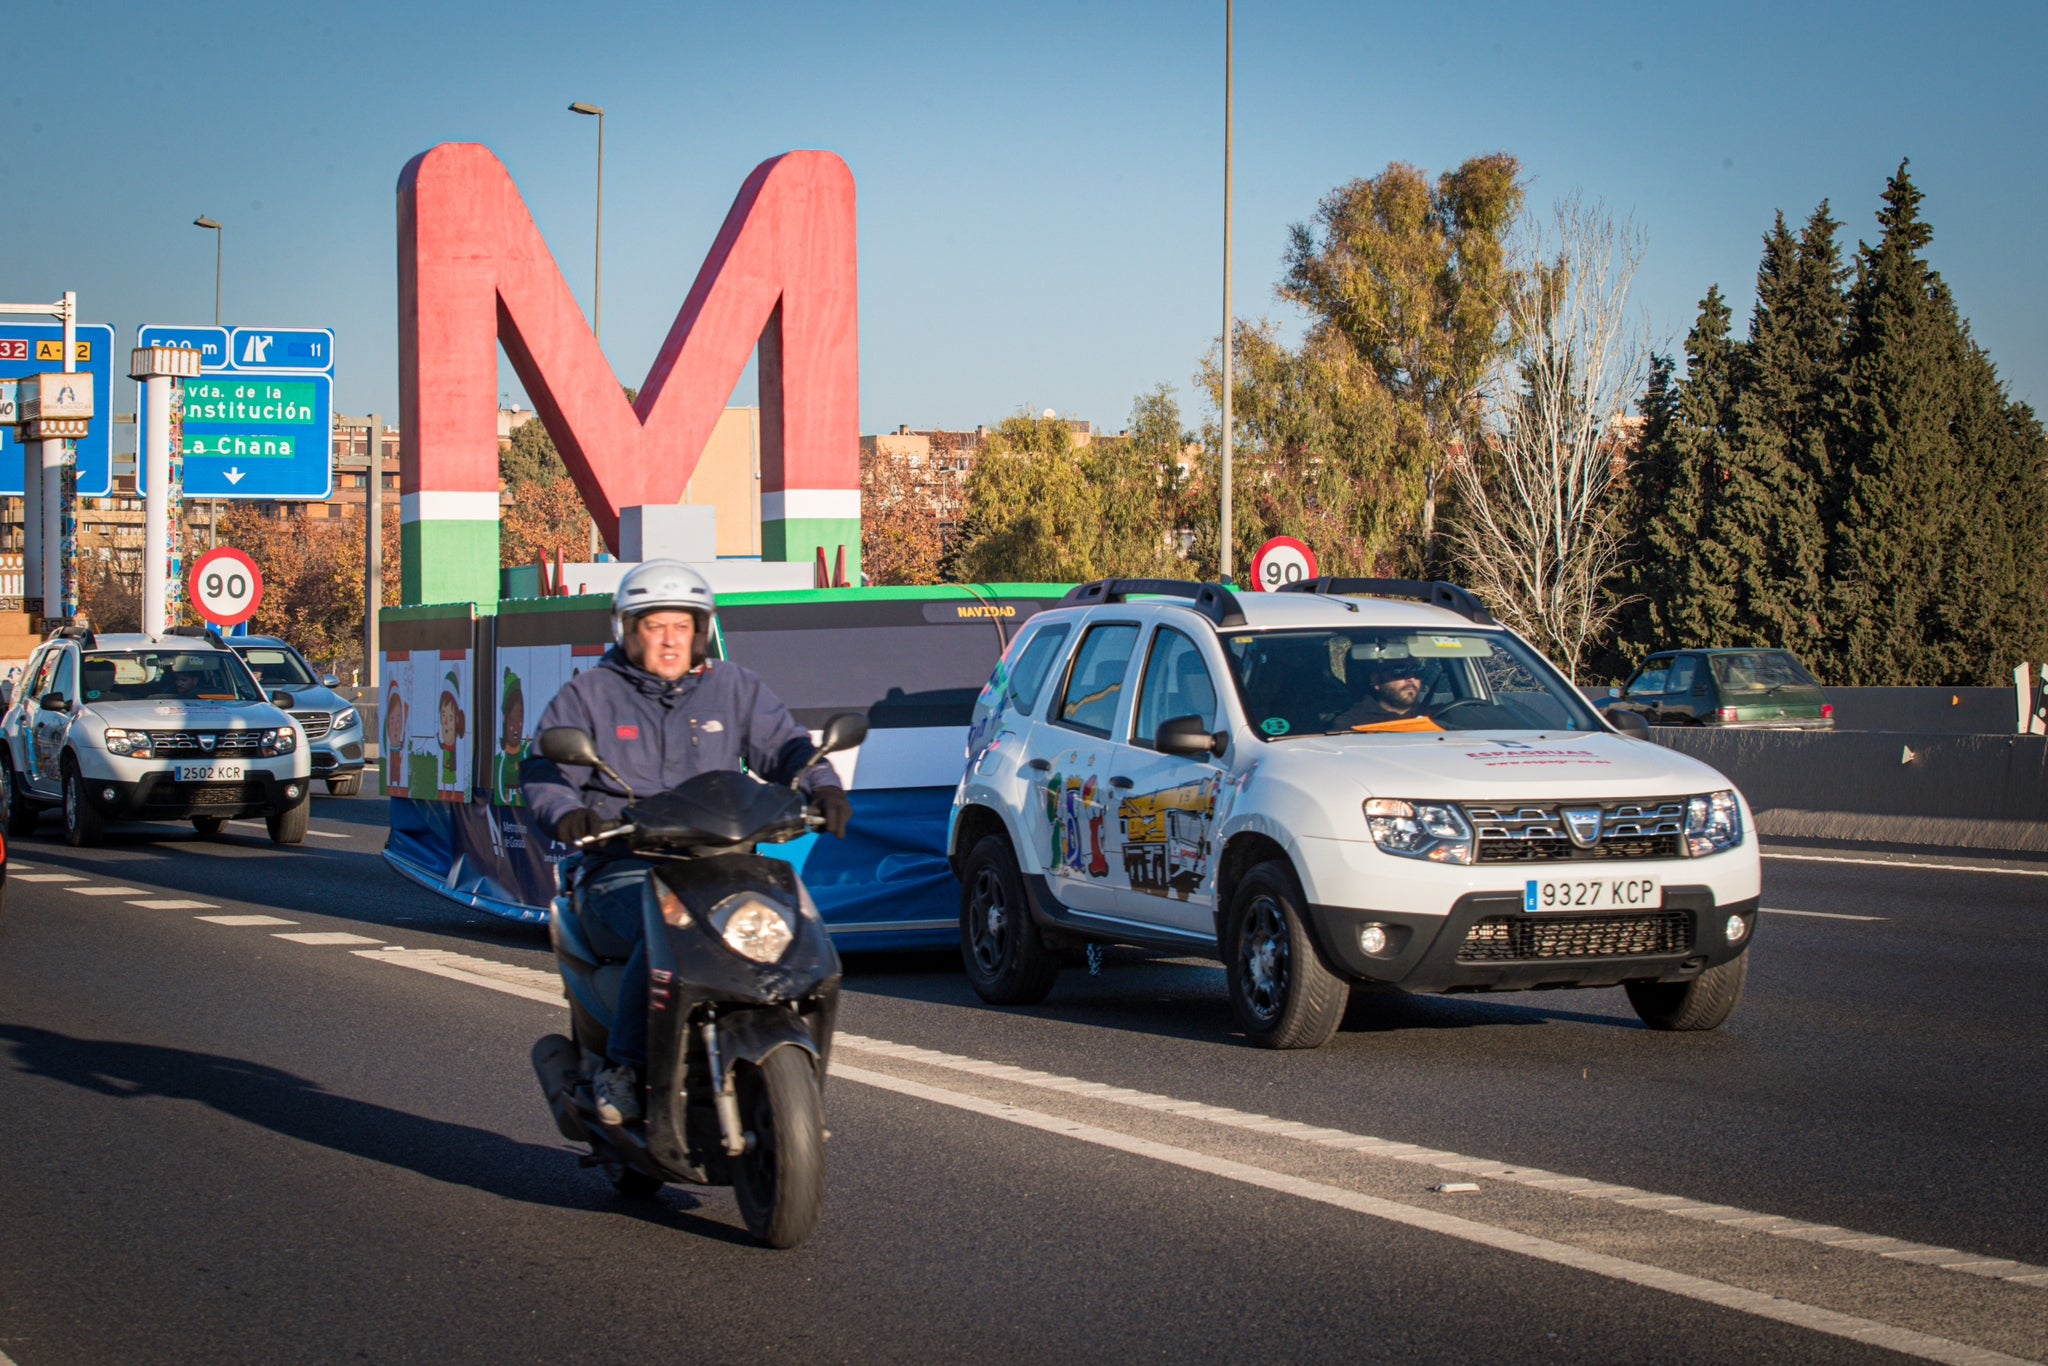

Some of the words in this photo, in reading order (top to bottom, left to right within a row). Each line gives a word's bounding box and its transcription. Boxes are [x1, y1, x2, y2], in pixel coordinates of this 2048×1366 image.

[40, 343, 88, 358] A-2
[202, 343, 218, 355] m
[310, 343, 321, 357] 11
[184, 384, 224, 398] vda.
[235, 385, 256, 398] de
[266, 386, 281, 399] la
[183, 402, 311, 420] nstitución
[217, 436, 291, 455] Chana
[1266, 562, 1302, 585] 90
[206, 573, 246, 599] 90
[957, 606, 1016, 618] NAVIDAD
[1465, 750, 1593, 758] ESPAGRUAS
[183, 767, 214, 779] 2502
[218, 766, 241, 778] KCR
[1543, 881, 1602, 906] 9327
[1612, 879, 1654, 904] KCP
